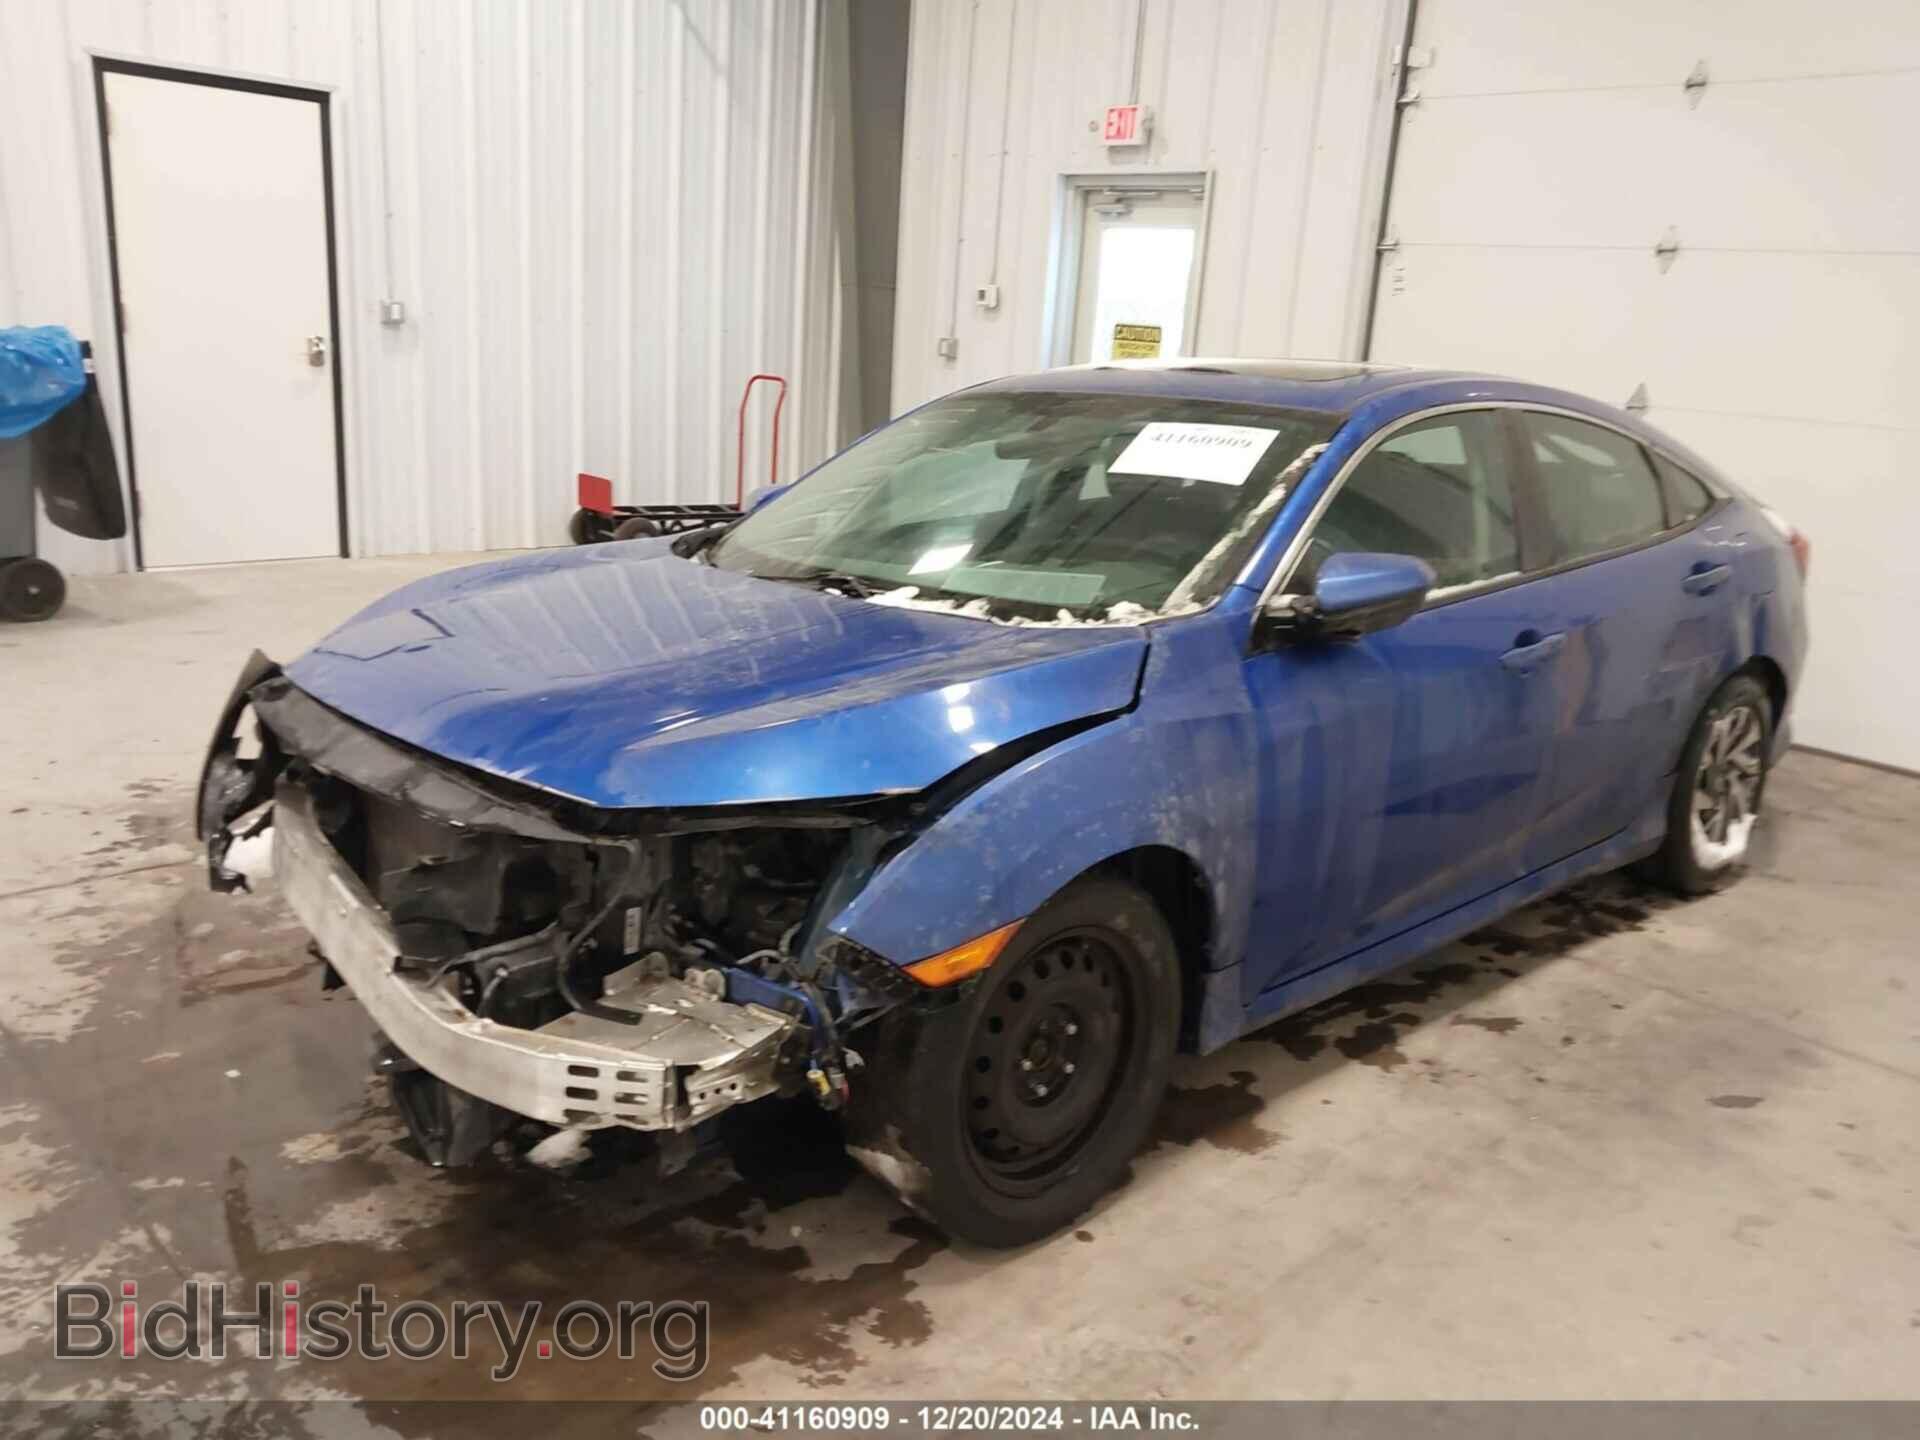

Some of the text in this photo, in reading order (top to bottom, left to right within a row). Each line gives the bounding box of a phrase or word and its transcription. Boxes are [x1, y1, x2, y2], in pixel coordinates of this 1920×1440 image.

[1105, 107, 1137, 140] EXIT
[1115, 326, 1160, 342] CAUTION
[1150, 432, 1253, 449] 41160909
